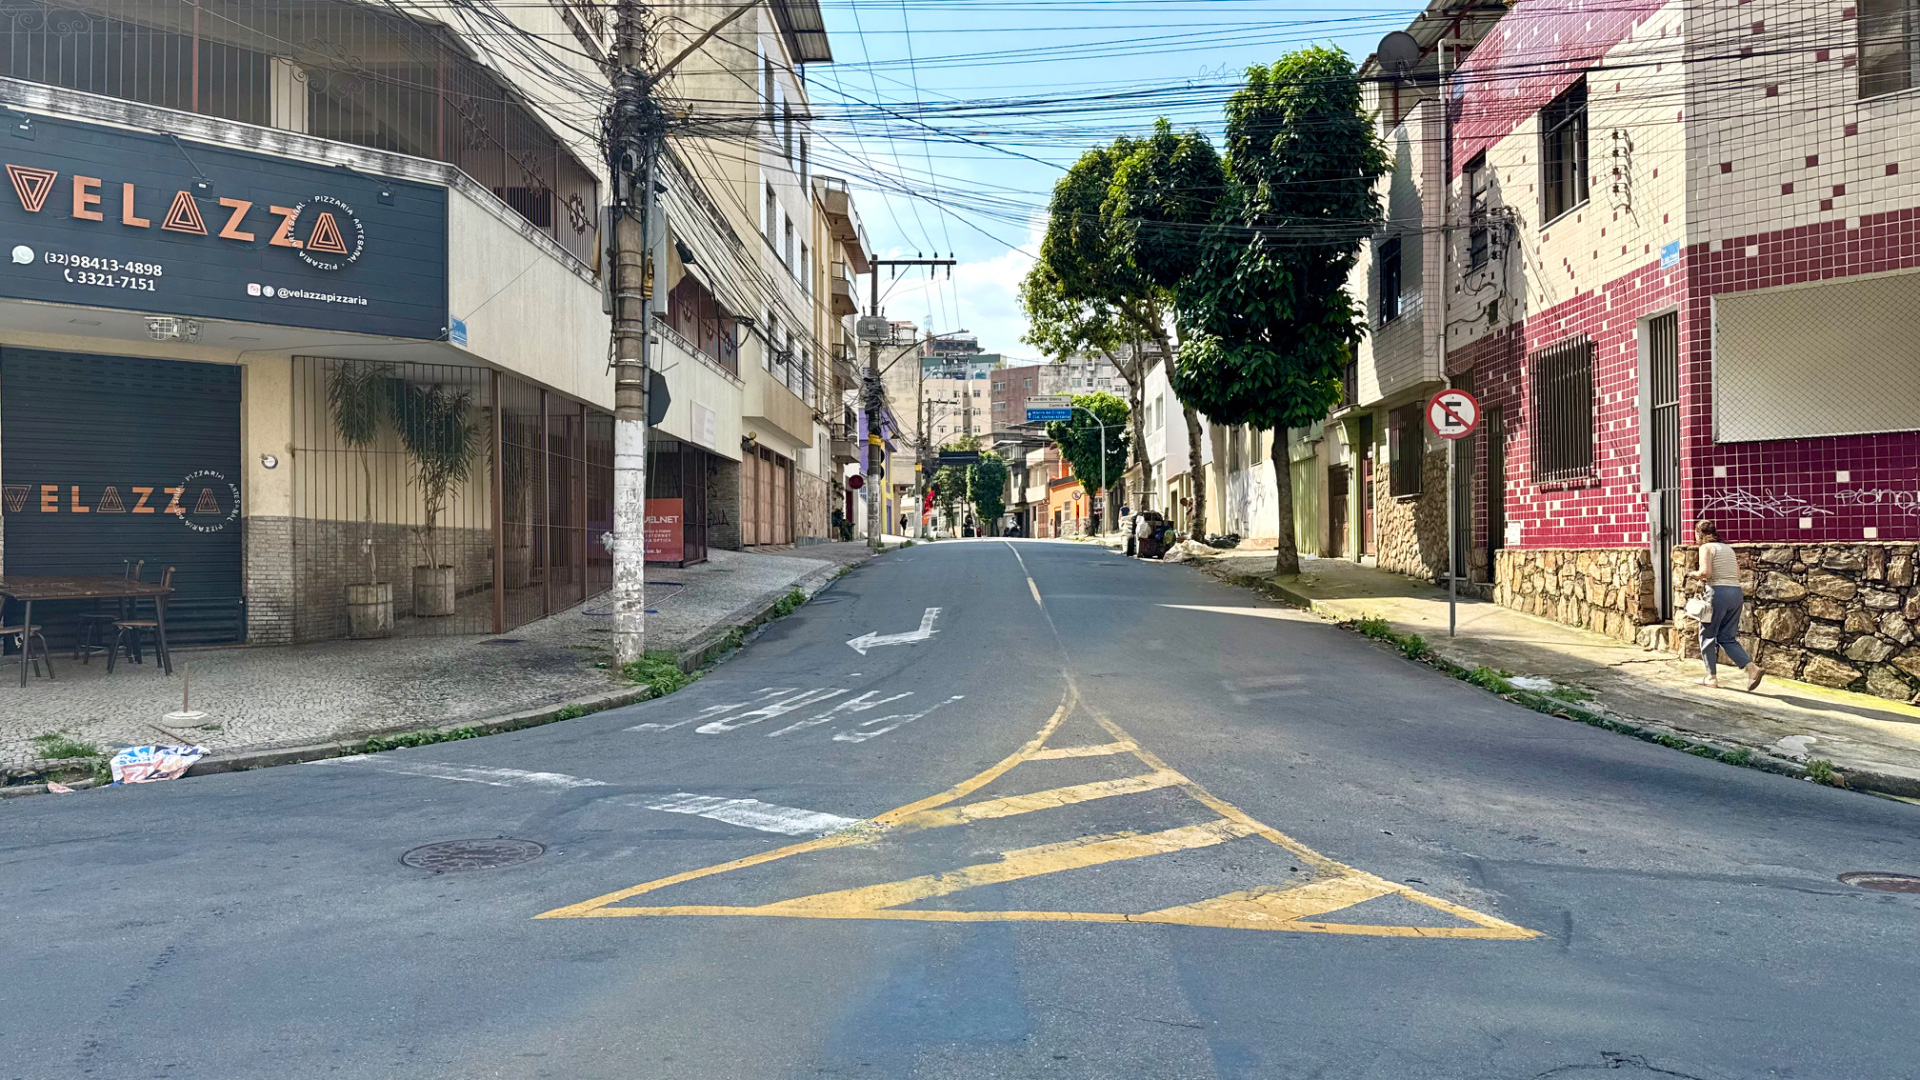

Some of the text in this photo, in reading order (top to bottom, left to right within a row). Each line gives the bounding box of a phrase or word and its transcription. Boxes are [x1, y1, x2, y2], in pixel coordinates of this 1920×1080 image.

[5, 163, 348, 255] VELAZZA
[314, 195, 365, 263] PIZZARIA ARTESANAL
[299, 250, 338, 270] PIZZARIA
[77, 271, 156, 291] 3321-7151
[277, 287, 368, 305] @velazzapizzaria
[2, 484, 221, 514] VELAZZA
